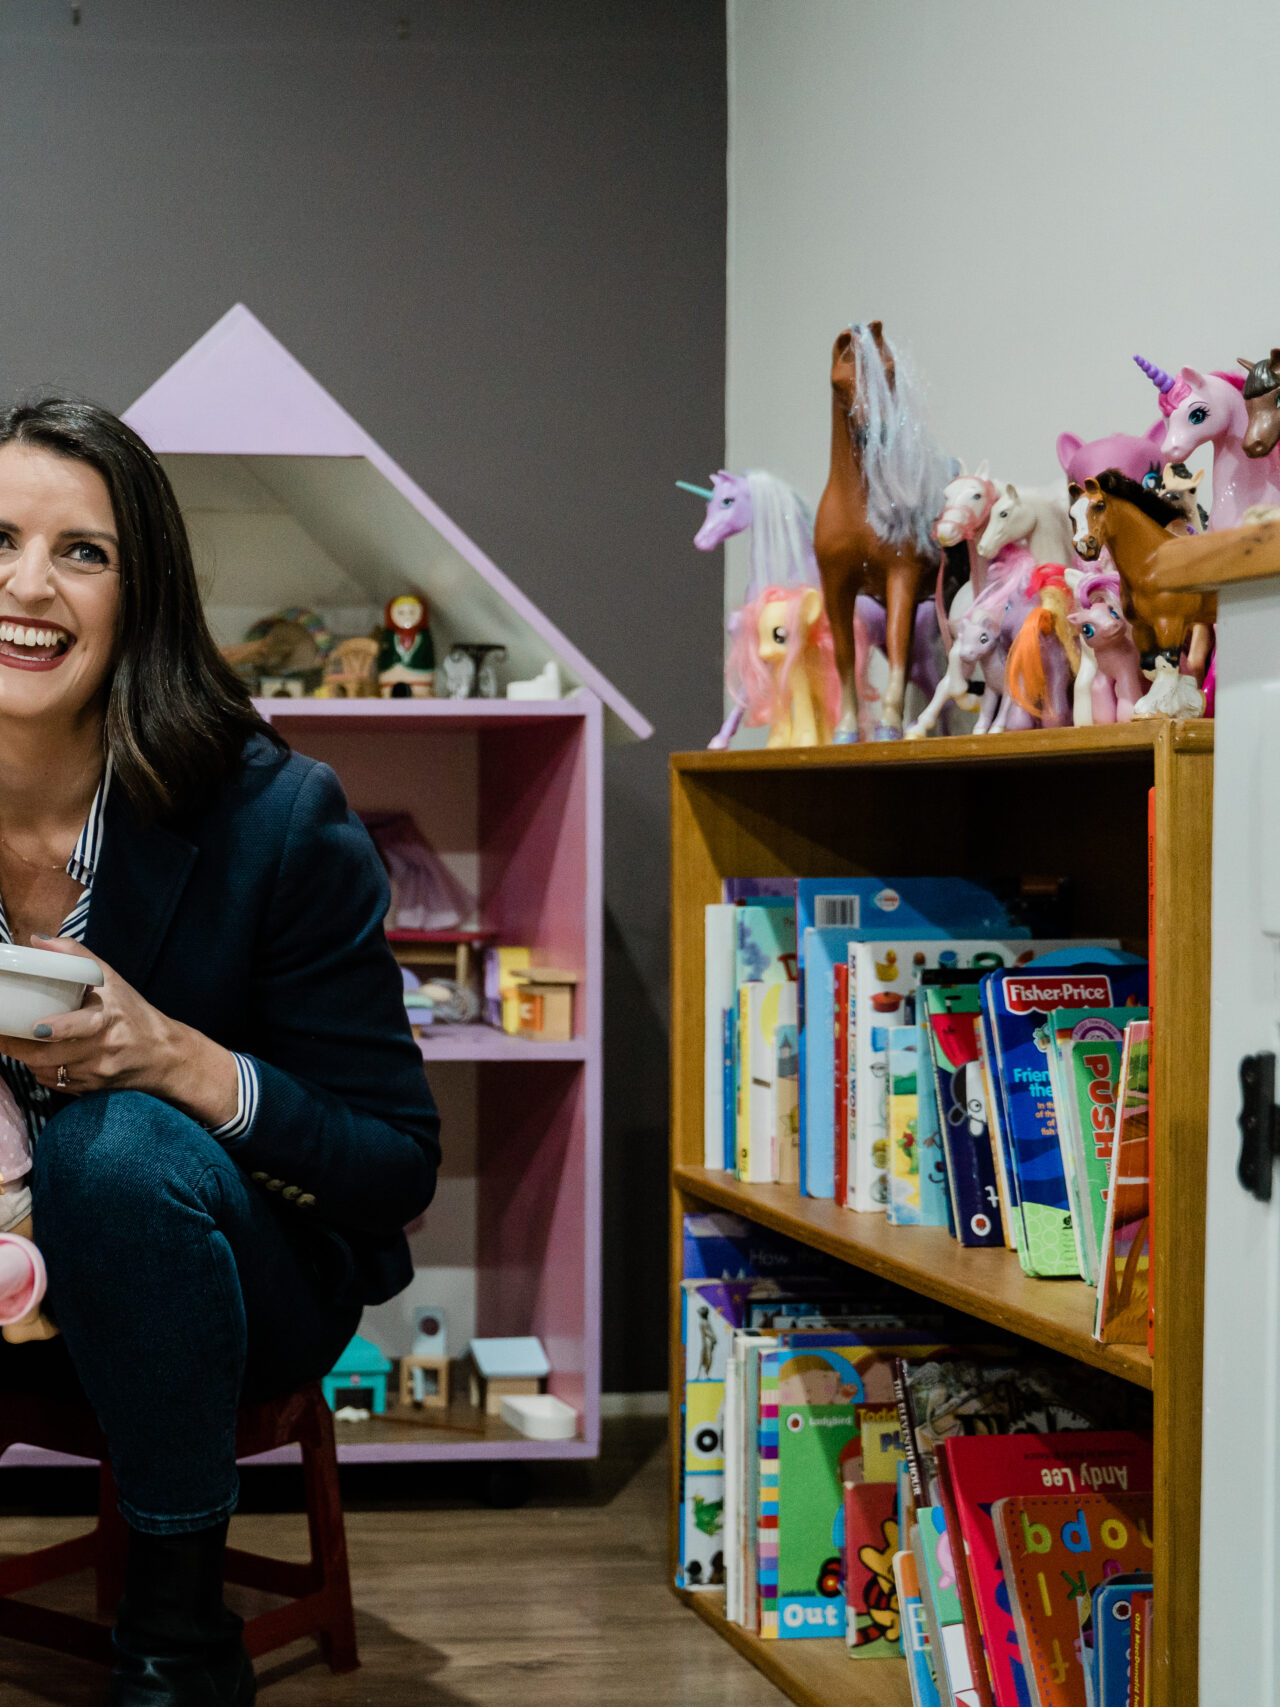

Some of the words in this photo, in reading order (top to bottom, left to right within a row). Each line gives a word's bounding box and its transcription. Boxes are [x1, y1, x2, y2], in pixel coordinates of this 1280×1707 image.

[849, 954, 857, 980] MY
[1009, 983, 1106, 1002] Fisher-Price
[1013, 1067, 1051, 1083] Frien
[849, 1078, 857, 1141] WORDS
[1083, 1054, 1116, 1160] PUSH
[893, 1378, 904, 1400] THE
[857, 1407, 898, 1422] Todd
[897, 1402, 915, 1461] ELEVENTH
[908, 1462, 922, 1496] HOUR
[1040, 1467, 1076, 1493] Lee
[1079, 1462, 1128, 1491] Andy
[783, 1603, 838, 1628] Out
[1133, 1632, 1141, 1694] MacDonald
